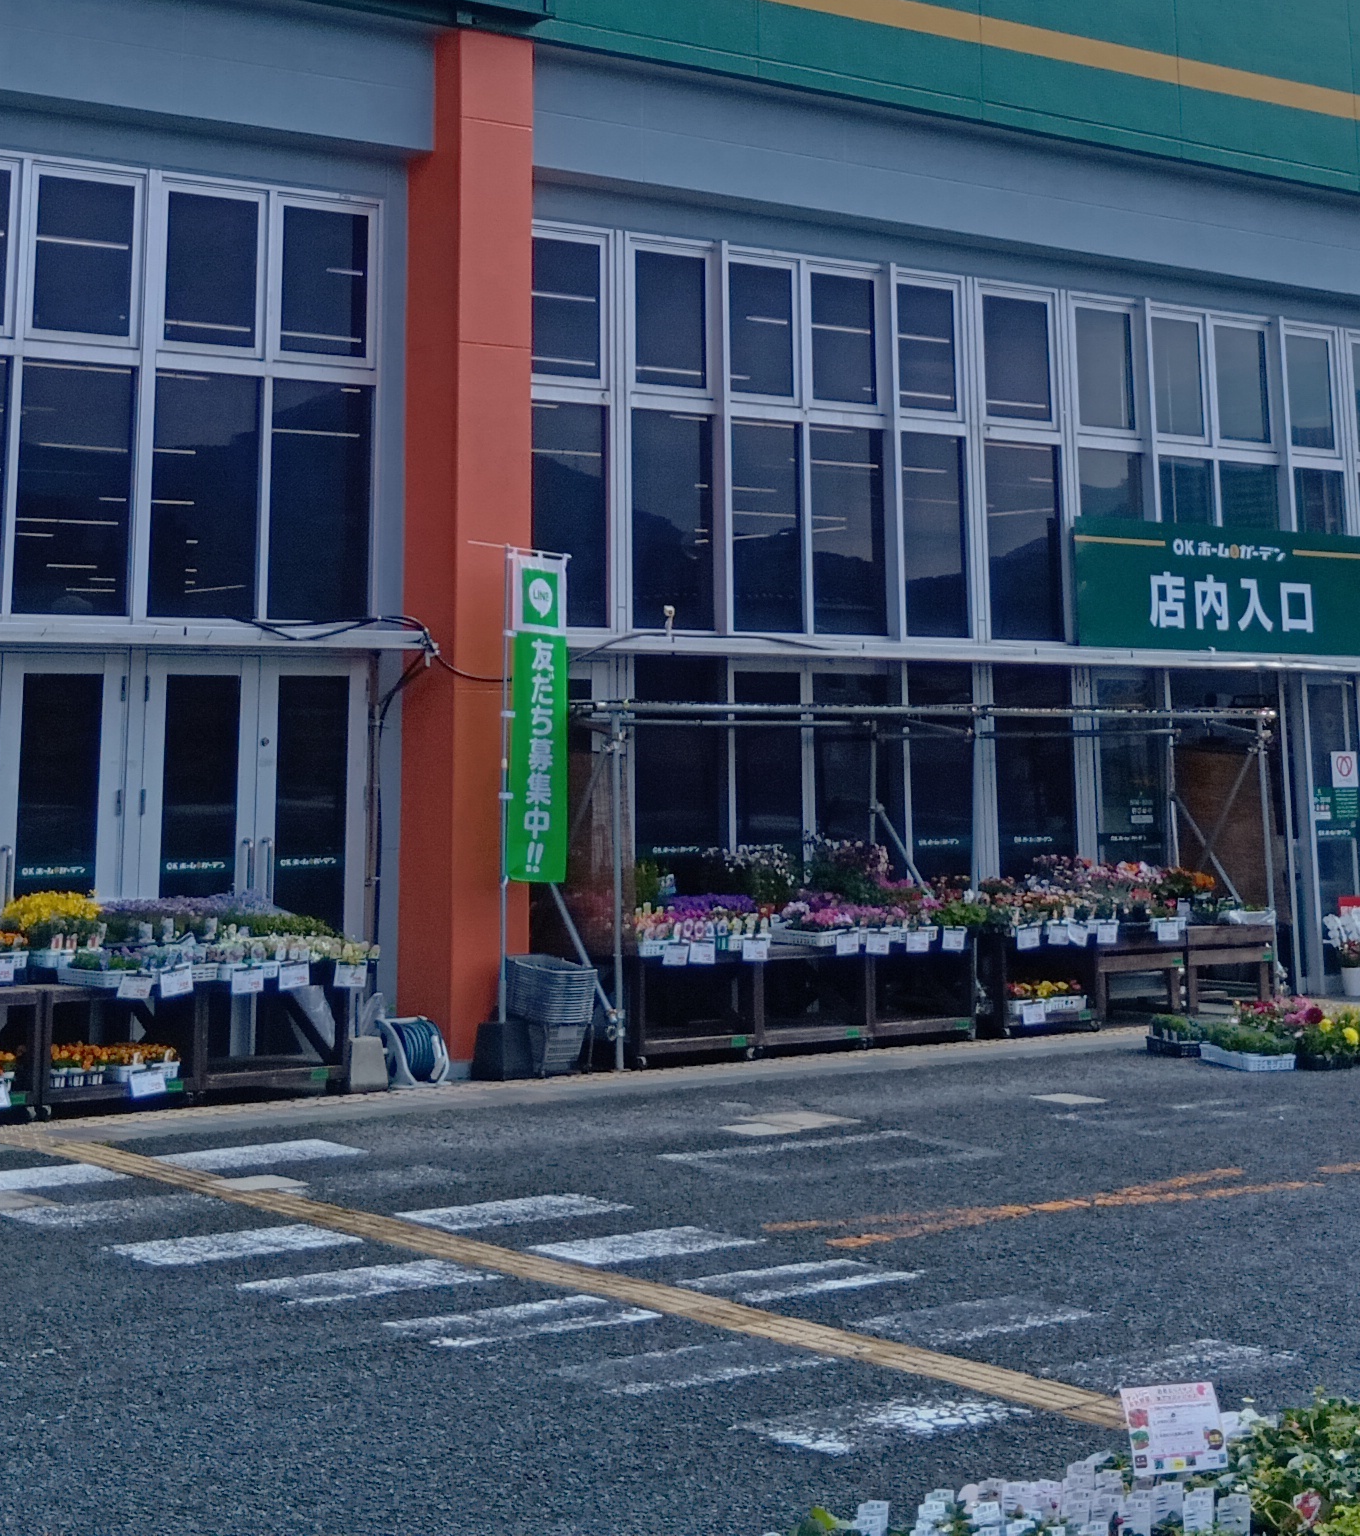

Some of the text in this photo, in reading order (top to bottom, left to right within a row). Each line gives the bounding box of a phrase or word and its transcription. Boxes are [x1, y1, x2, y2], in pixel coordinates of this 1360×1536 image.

[1173, 538, 1195, 557] OK
[533, 589, 549, 602] LINE
[1149, 571, 1314, 633] 店内入口
[523, 638, 555, 873] 友だち募集中!!
[22, 867, 34, 876] OK
